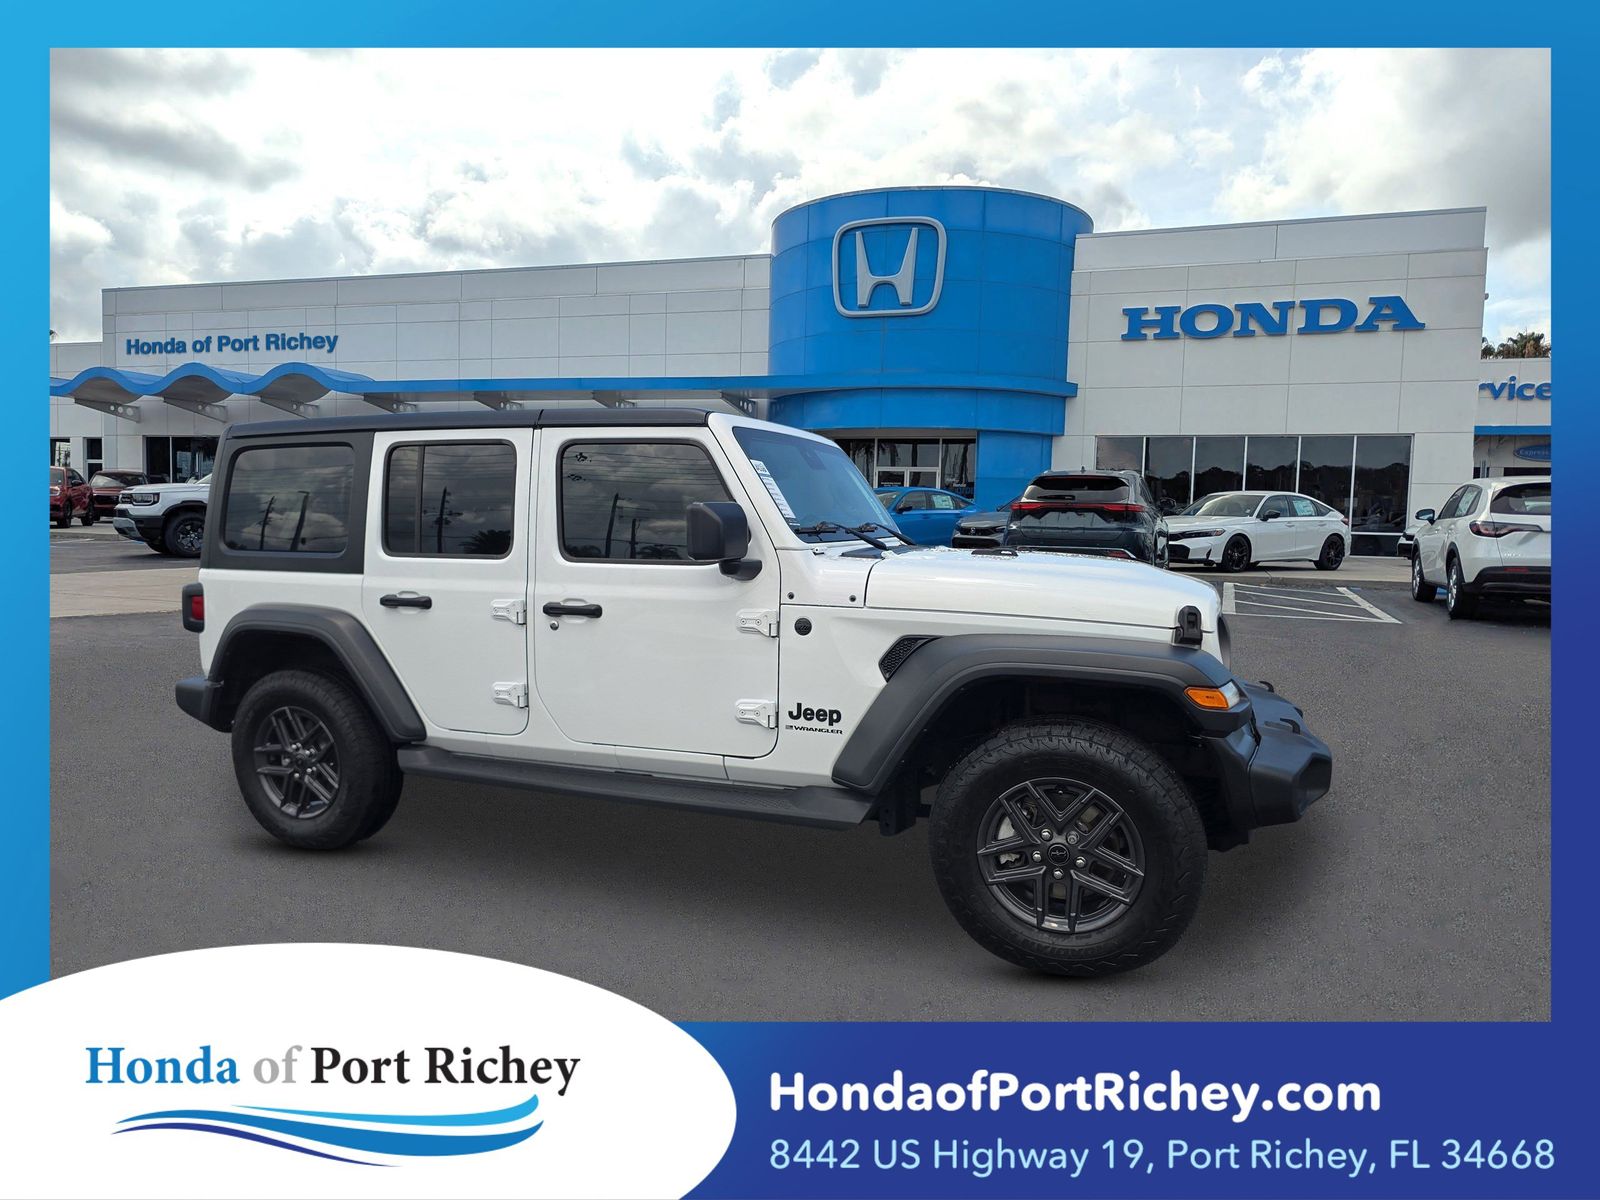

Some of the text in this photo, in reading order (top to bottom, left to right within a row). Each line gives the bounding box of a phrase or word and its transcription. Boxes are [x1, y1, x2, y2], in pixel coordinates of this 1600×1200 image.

[1121, 296, 1424, 340] HONDA
[125, 331, 338, 356] Honda of Port Richey
[787, 702, 842, 726] Jeep
[793, 725, 843, 734] WRANGLER
